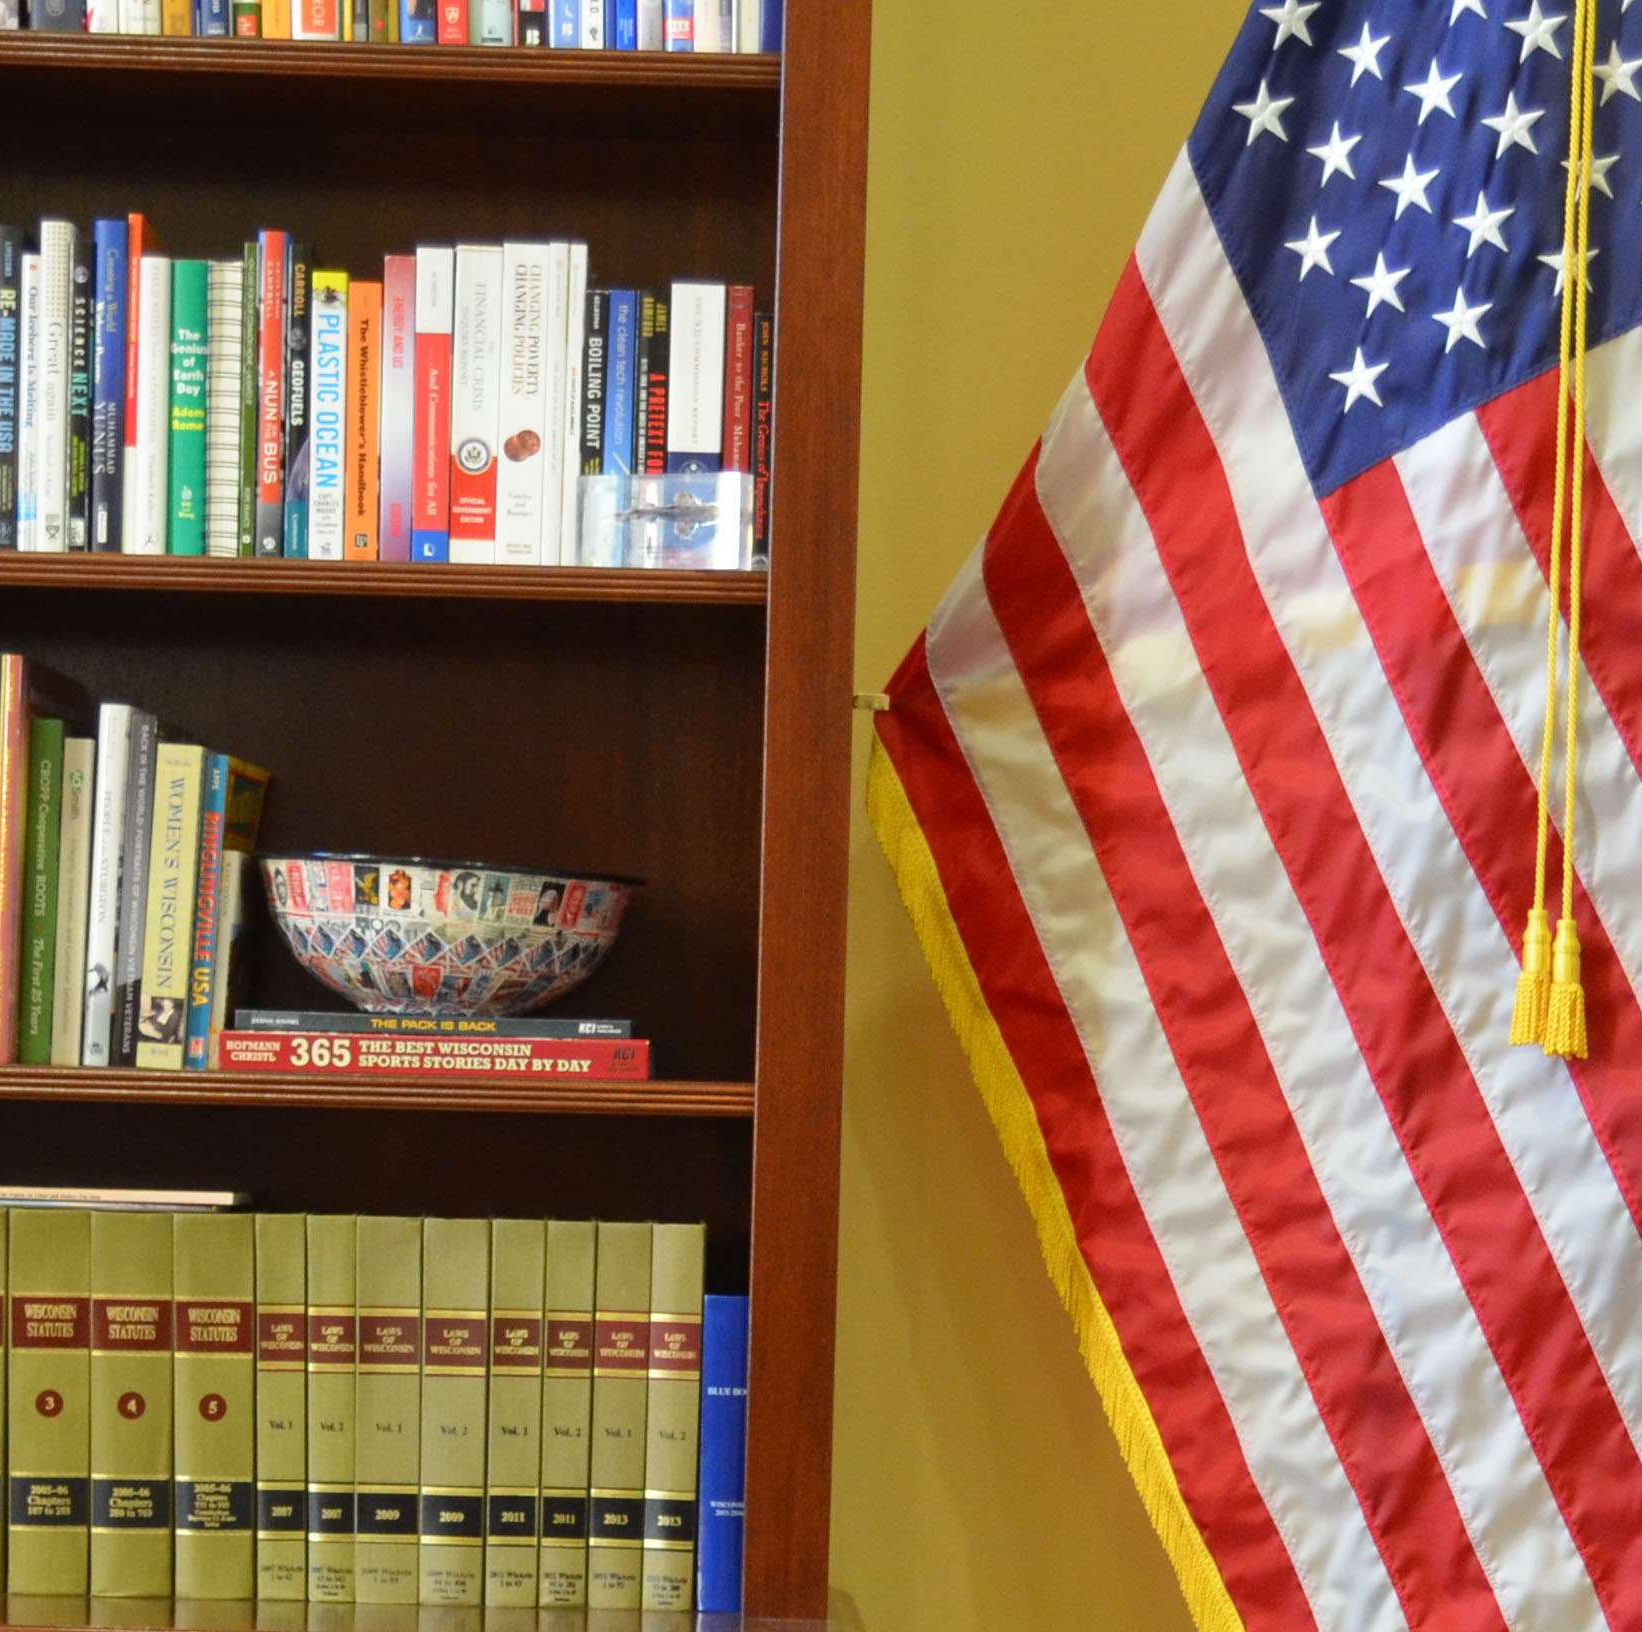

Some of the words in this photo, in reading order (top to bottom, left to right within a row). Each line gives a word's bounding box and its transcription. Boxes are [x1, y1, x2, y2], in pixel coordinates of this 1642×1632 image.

[28, 285, 39, 309] Our
[267, 261, 277, 320] CAMPBELL
[293, 264, 306, 318] CARROLL
[513, 263, 529, 331] CHANGING
[528, 264, 543, 332] CHANGING
[0, 289, 17, 363] RE-MADE
[73, 296, 87, 367] SCIENCE
[178, 329, 201, 340] The
[359, 318, 370, 344] The
[473, 283, 489, 363] FINANCIAL
[618, 304, 630, 325] the
[26, 315, 39, 361] Iceberg
[47, 321, 64, 375] Great
[172, 342, 207, 354] Genius
[317, 313, 341, 403] PLASTIC
[616, 326, 629, 358] clean
[28, 364, 39, 376] Is
[173, 369, 204, 382] Earth
[182, 356, 196, 368] of
[511, 336, 527, 396] POLICIES
[525, 335, 541, 402] POVERTY,
[587, 337, 604, 400] BOILING
[615, 361, 629, 385] tech
[25, 380, 38, 430] Melting
[43, 383, 57, 422] again
[71, 371, 89, 417] NEXT
[176, 383, 200, 397] Day
[290, 360, 305, 427] GEOFUELS
[357, 346, 369, 450] Whistleblower's
[470, 367, 486, 412] CRISIS
[172, 407, 205, 419] Adam
[585, 403, 602, 450] POINT
[613, 388, 627, 445] revolution
[93, 400, 108, 475] YUNUS
[106, 401, 117, 475] MUHAMMAD
[315, 411, 340, 489] OCEAN
[263, 442, 279, 485] BUS
[356, 453, 369, 517] Handbook
[39, 759, 53, 802] CROPP
[36, 803, 51, 872] Cooperative
[163, 777, 186, 869] WOMEN'S
[33, 875, 47, 918] ROOTS
[194, 812, 222, 963] RINGLINGVILLE
[156, 877, 180, 989] WISCONSIN
[192, 967, 211, 1007] USA
[226, 1040, 281, 1052] HOFMANN
[371, 1018, 397, 1030] THE
[401, 1019, 436, 1031] PACK
[441, 1021, 455, 1031] IS
[458, 1022, 496, 1032] BACK
[230, 1052, 277, 1063] CHRISTL
[290, 1037, 352, 1068] 365
[358, 1055, 421, 1069] SPORTS
[423, 1056, 491, 1071] STORIES
[494, 1058, 530, 1072] DAY
[532, 1060, 555, 1073] BY
[557, 1060, 592, 1073] DAY
[359, 1041, 392, 1054] THE
[395, 1042, 435, 1055] BEST
[438, 1042, 532, 1057] WISCONSIN
[24, 1303, 77, 1319] WISCONSIN
[26, 1321, 75, 1338] STATUTES
[106, 1305, 159, 1322] WISCONSIN
[108, 1323, 156, 1340] STATUTES
[188, 1307, 241, 1325] WISCONSIN
[190, 1325, 238, 1343] STATUTES
[44, 1396, 55, 1410] 3
[126, 1398, 138, 1413] 4
[207, 1400, 218, 1415] 5
